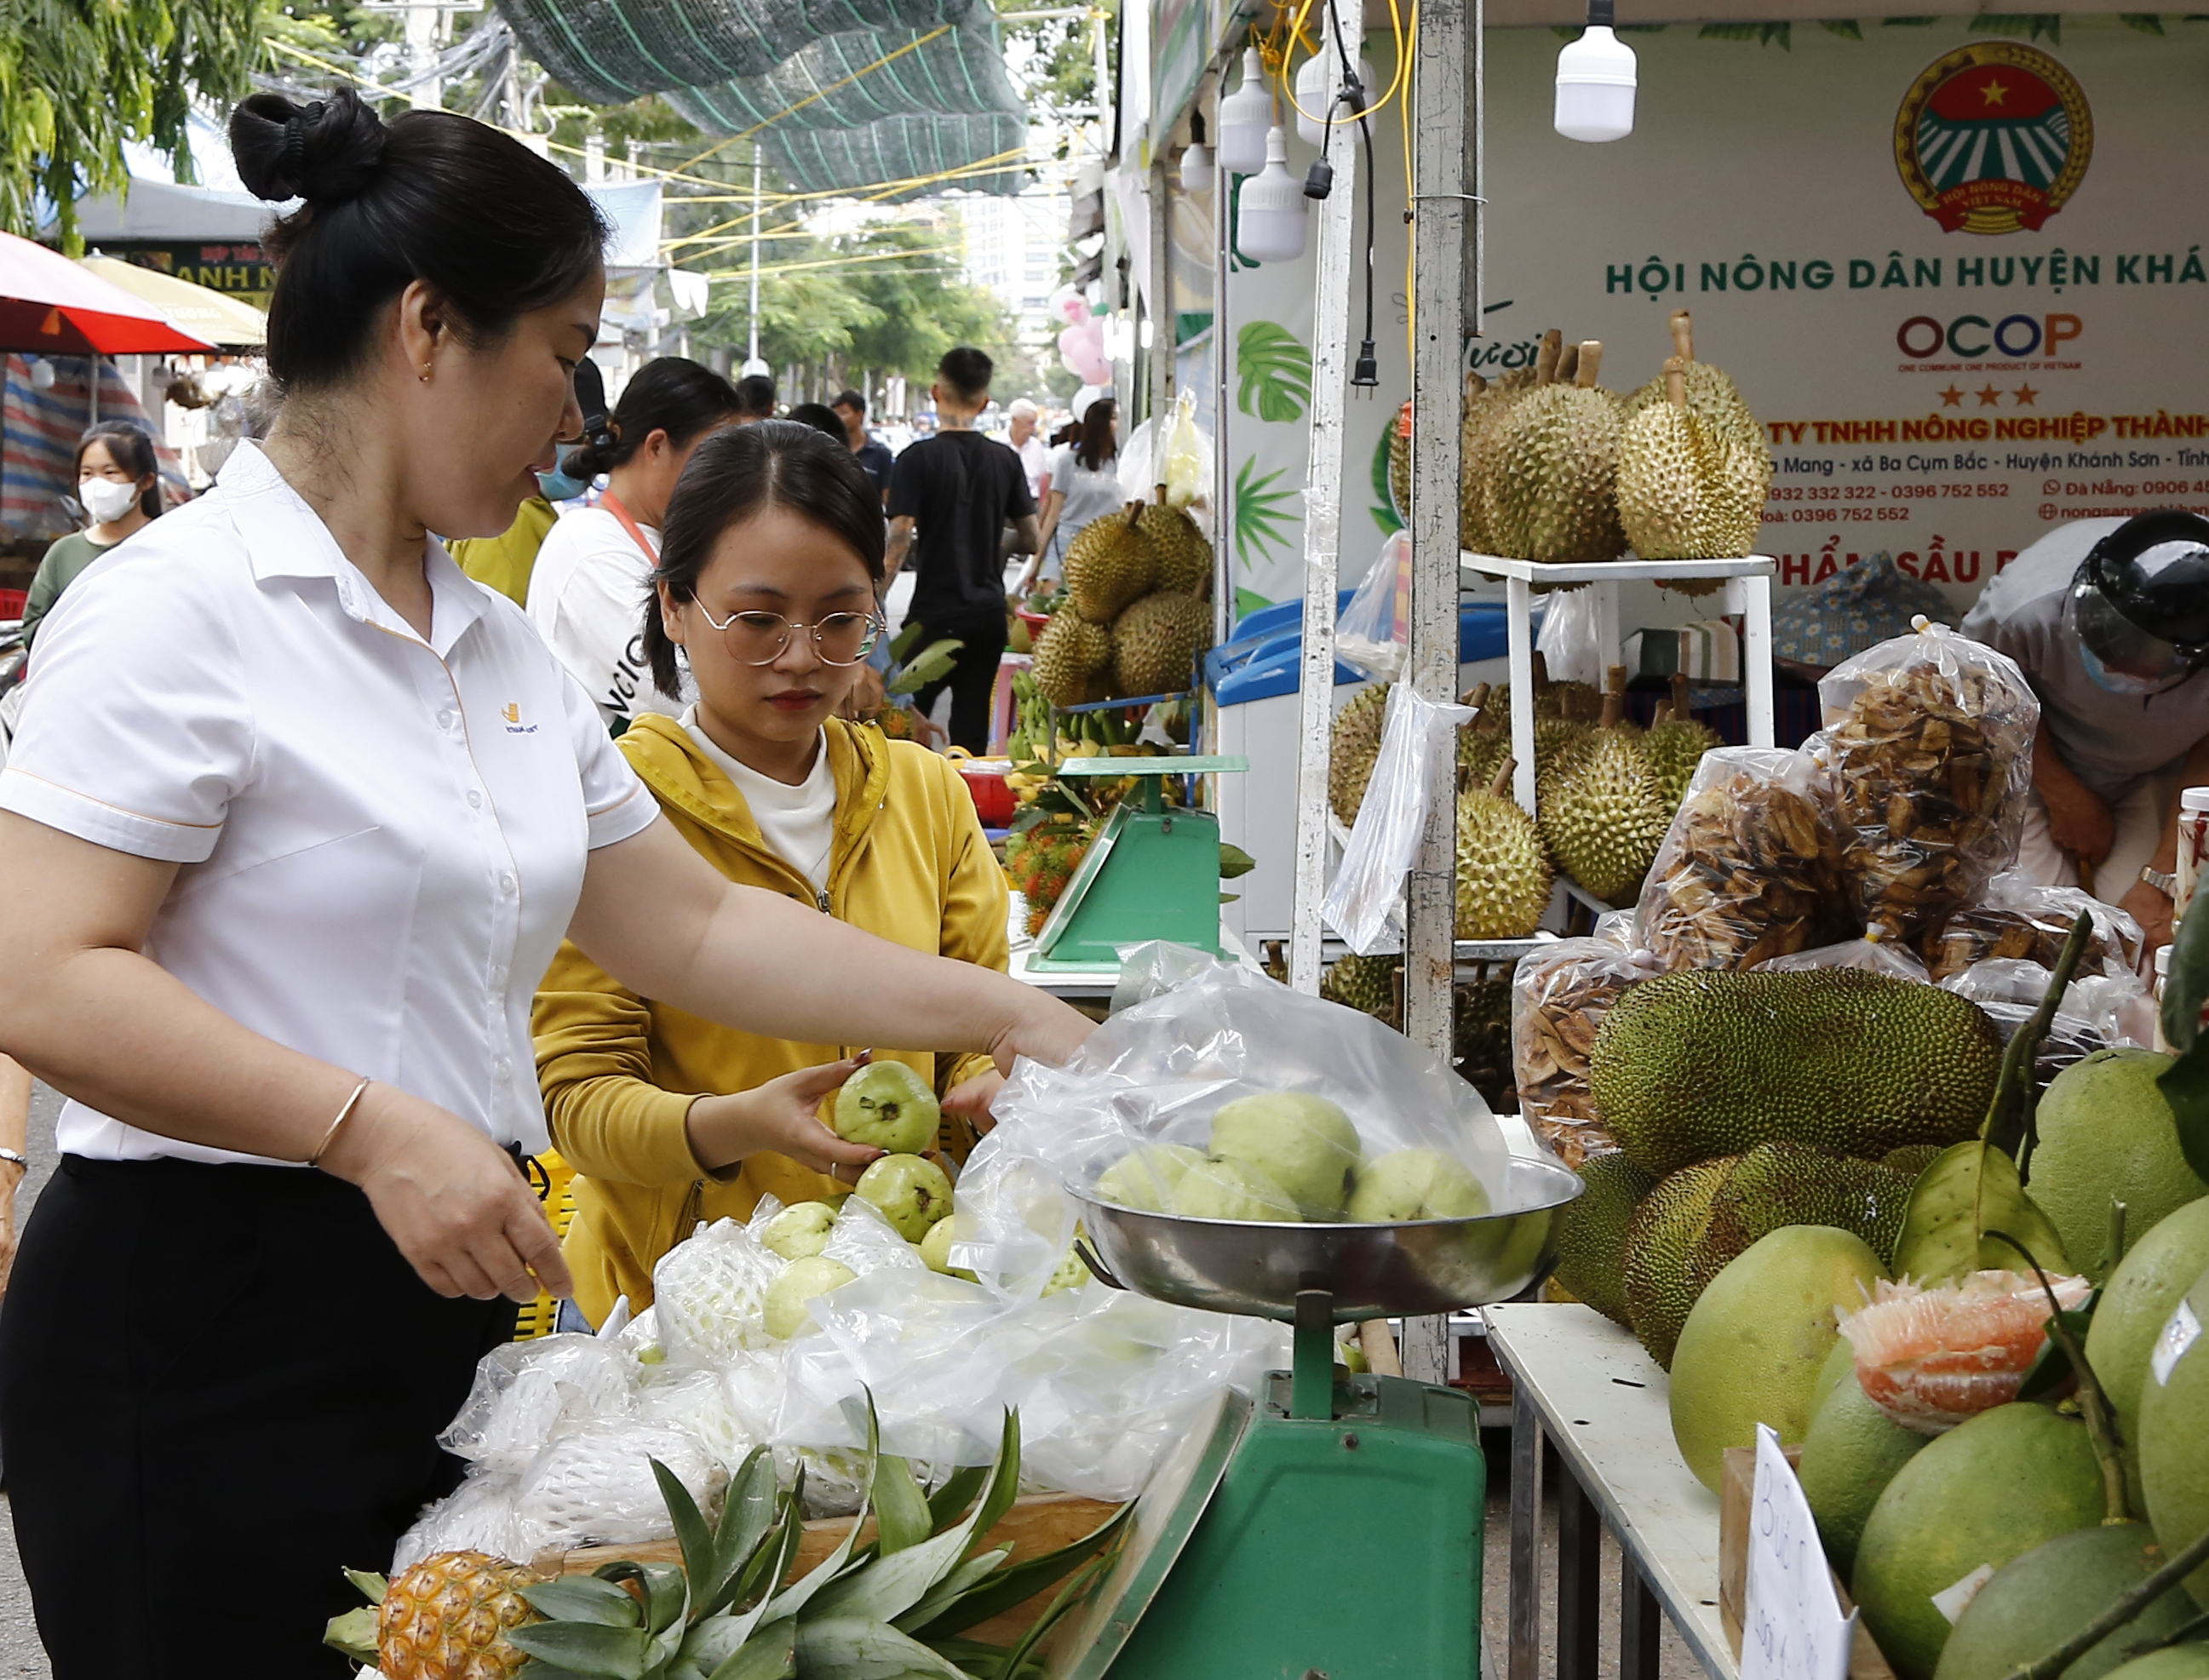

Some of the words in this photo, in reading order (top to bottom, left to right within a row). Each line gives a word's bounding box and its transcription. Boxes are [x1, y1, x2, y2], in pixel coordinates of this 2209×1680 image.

[1606, 254, 1685, 302] HỘI
[1701, 253, 1835, 292] NÔNG
[1848, 249, 1942, 290] DÂN
[1957, 247, 2100, 295] HUYỆN
[2116, 244, 2208, 284] KHÁ
[1896, 312, 2084, 359] OCOP
[1767, 421, 1806, 444] TY
[1812, 420, 1897, 444] TNHH
[1902, 412, 1990, 442] NÔNG
[1994, 410, 2107, 445] NGHIỆP
[1784, 456, 1834, 476] Mang
[1879, 455, 1902, 471] Ba
[1907, 454, 1948, 475] Cụm
[1954, 450, 1988, 470] Bắc
[2006, 452, 2062, 473] Huyện
[2068, 450, 2123, 469] Khánh
[2128, 450, 2160, 467] Sơn
[1808, 486, 1840, 501] 332
[1844, 485, 1877, 500] 322
[1891, 485, 1937, 499] 0396
[1942, 484, 1973, 498] 752
[1976, 484, 2010, 497] 552
[2143, 480, 2189, 495] 0906
[1792, 508, 1838, 523] 0396
[1842, 507, 1873, 522] 752
[1877, 507, 1910, 522] 552
[1896, 534, 1981, 584] SẦU
